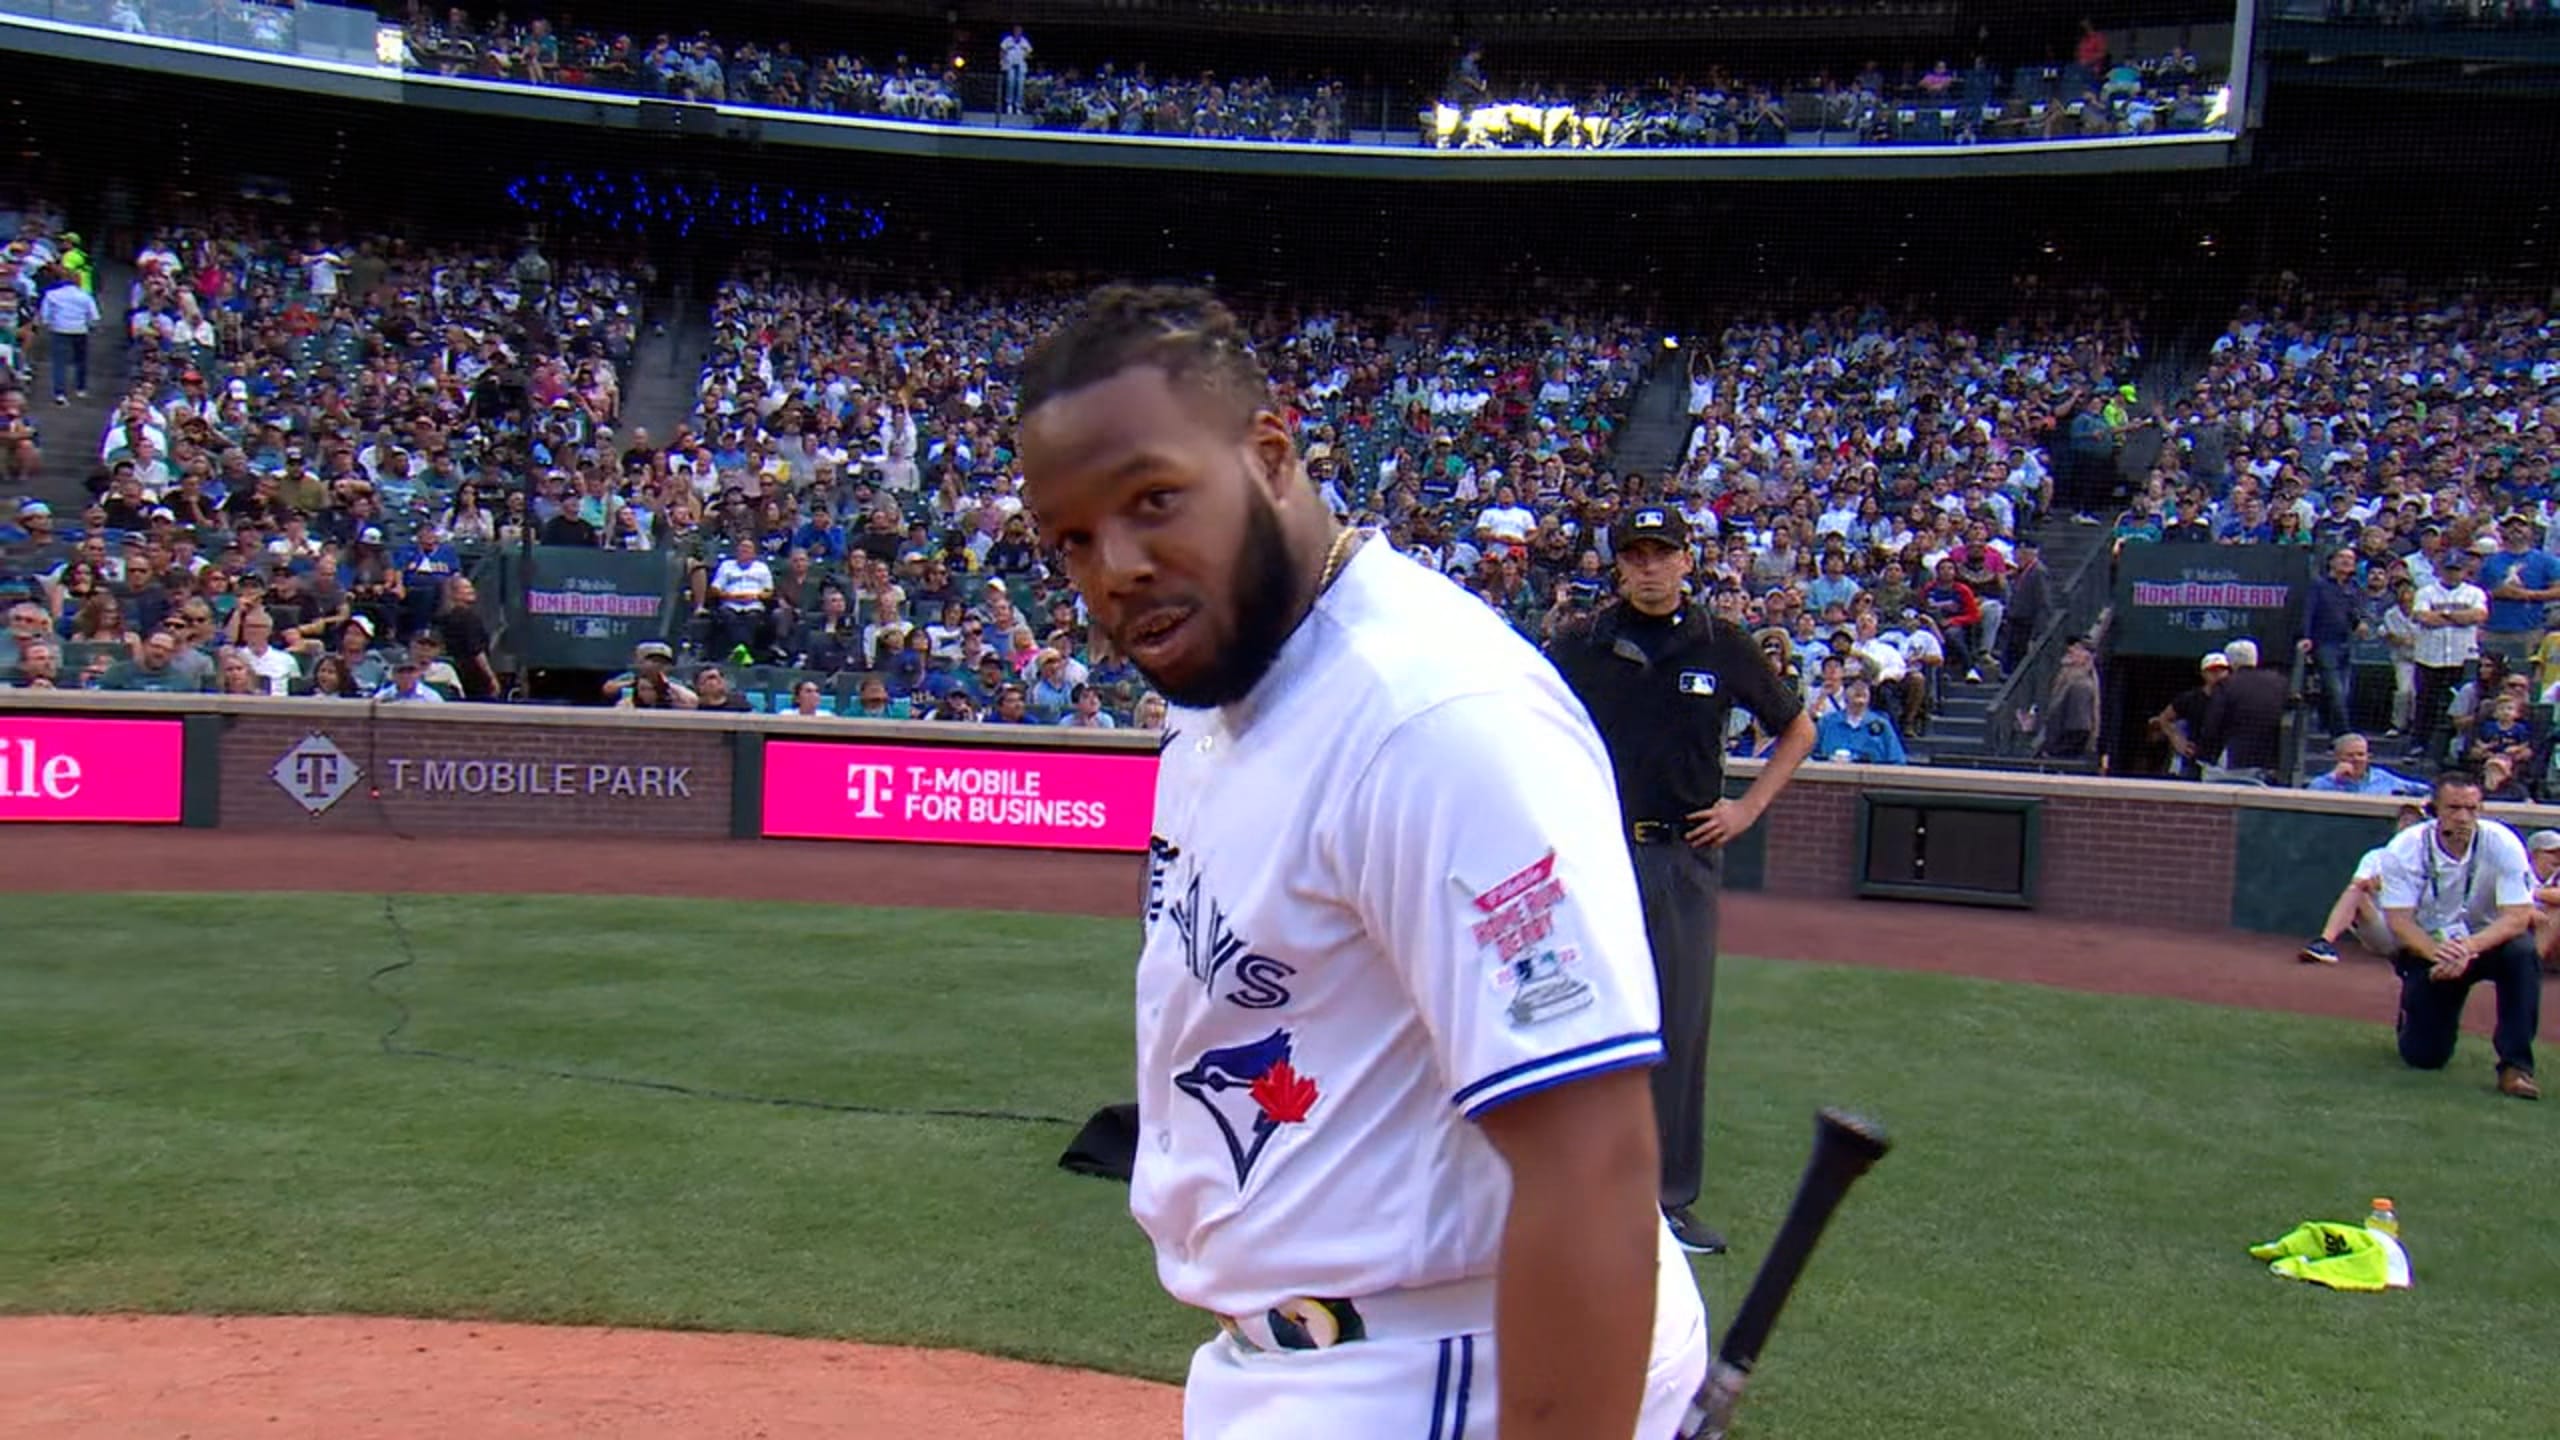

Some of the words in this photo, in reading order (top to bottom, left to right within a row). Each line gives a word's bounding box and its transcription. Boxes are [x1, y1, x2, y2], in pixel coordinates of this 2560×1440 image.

[388, 759, 577, 794] T-MOBILE
[588, 765, 692, 798] PARK
[906, 766, 1041, 797] T-MOBILE
[905, 794, 961, 822] FOR
[968, 798, 1107, 829] BUSINESS
